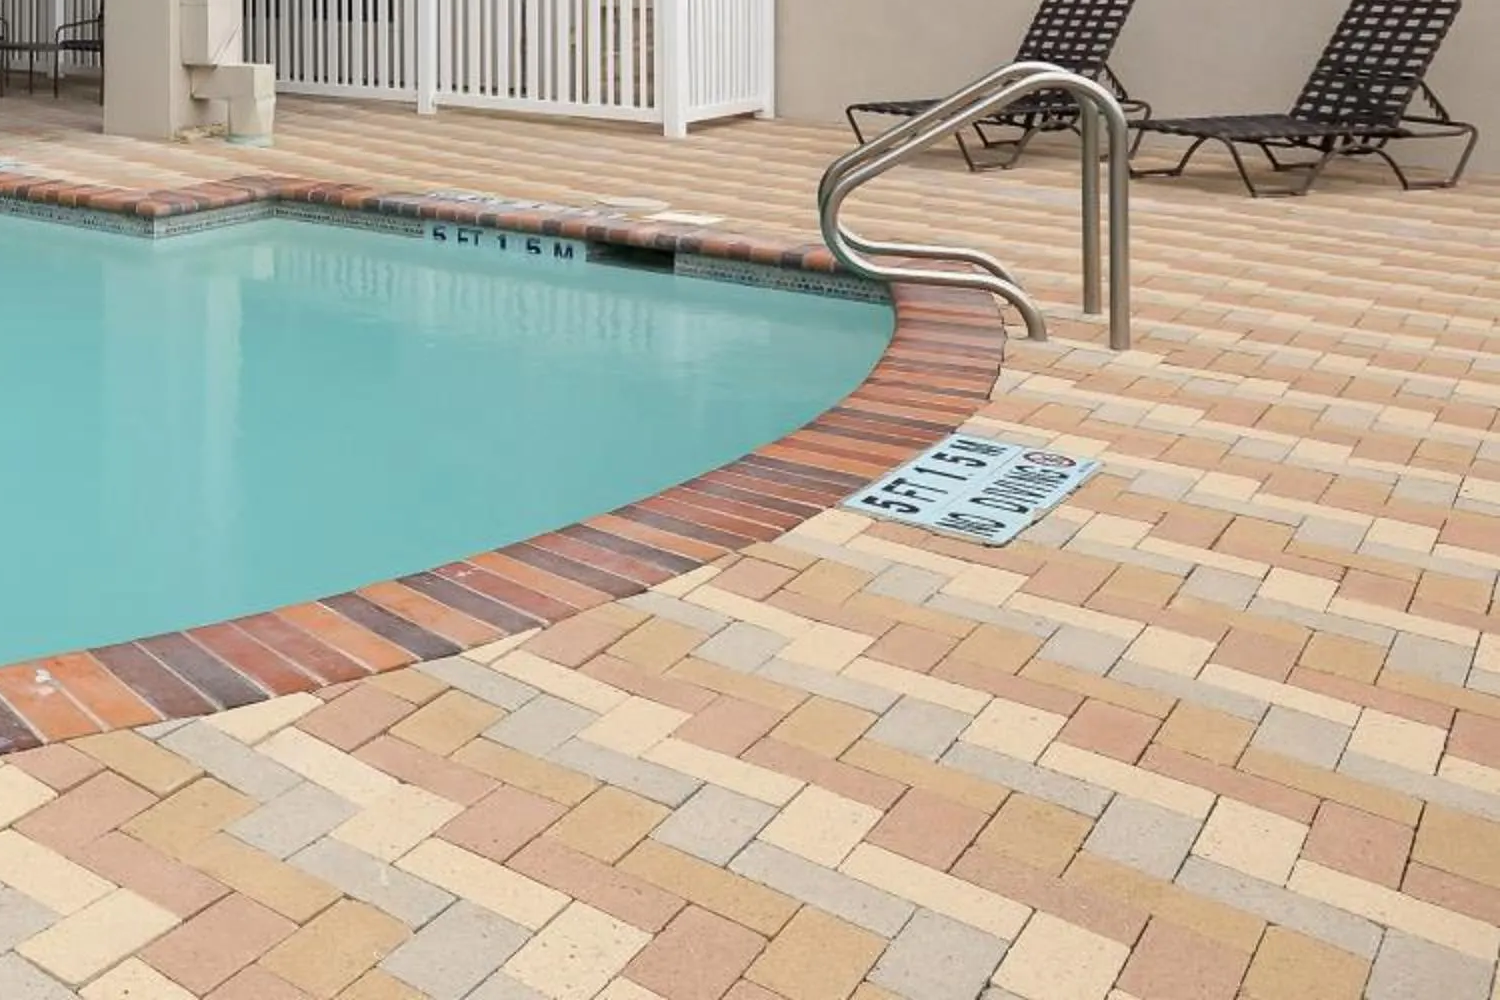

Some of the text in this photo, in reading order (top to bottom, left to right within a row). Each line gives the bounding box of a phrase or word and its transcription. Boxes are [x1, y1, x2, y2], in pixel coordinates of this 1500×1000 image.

[553, 242, 574, 260] M
[934, 465, 1070, 538] NO DIVING
